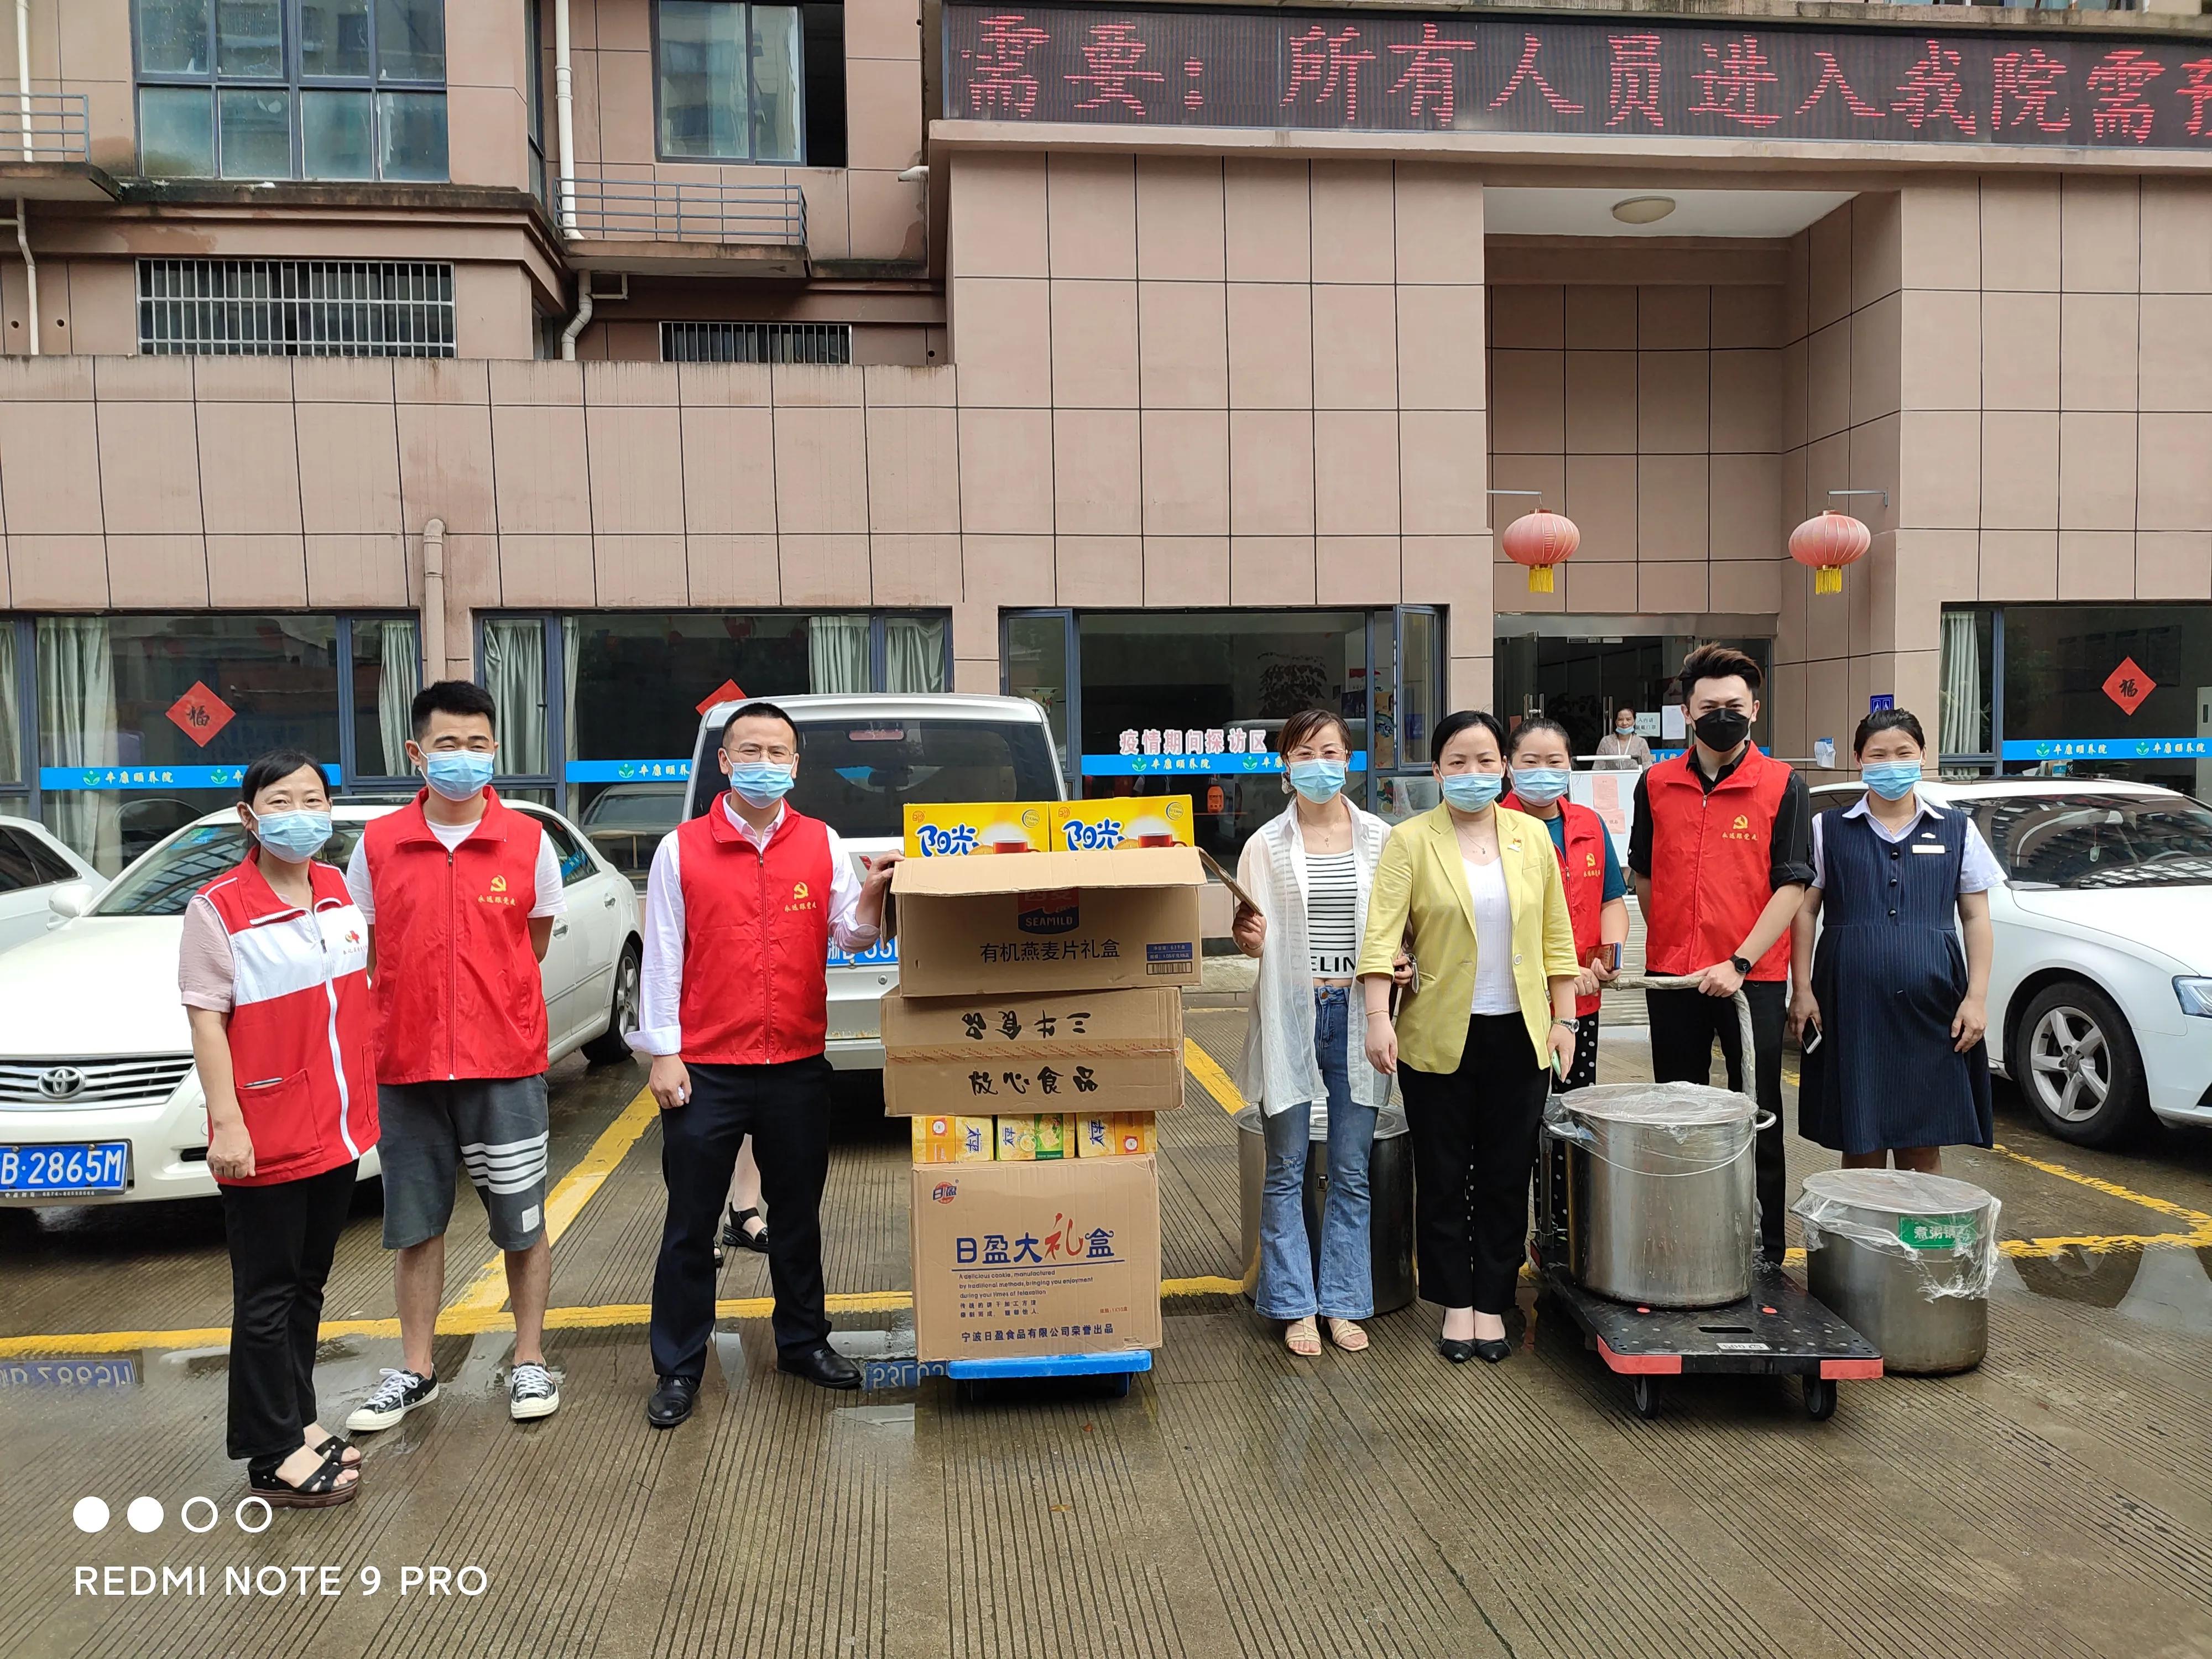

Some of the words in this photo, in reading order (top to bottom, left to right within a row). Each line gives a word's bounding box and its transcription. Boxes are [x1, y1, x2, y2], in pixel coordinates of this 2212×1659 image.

[2119, 679, 2138, 697] 福
[186, 705, 210, 727] 福
[1119, 728, 1267, 755] 疫情期间探访区
[916, 823, 978, 857] 阳光
[1063, 818, 1125, 851] 阳光
[1025, 916, 1073, 927] SEAMILD
[979, 938, 1120, 963] 有机燕麦片礼盒
[961, 1009, 1091, 1040] 三牛食品
[968, 1066, 1098, 1096] 放心食品
[956, 1213, 1115, 1264] 日盈大礼盒
[962, 1323, 1113, 1343] 宁波日盈食品有限公司荣誉出品
